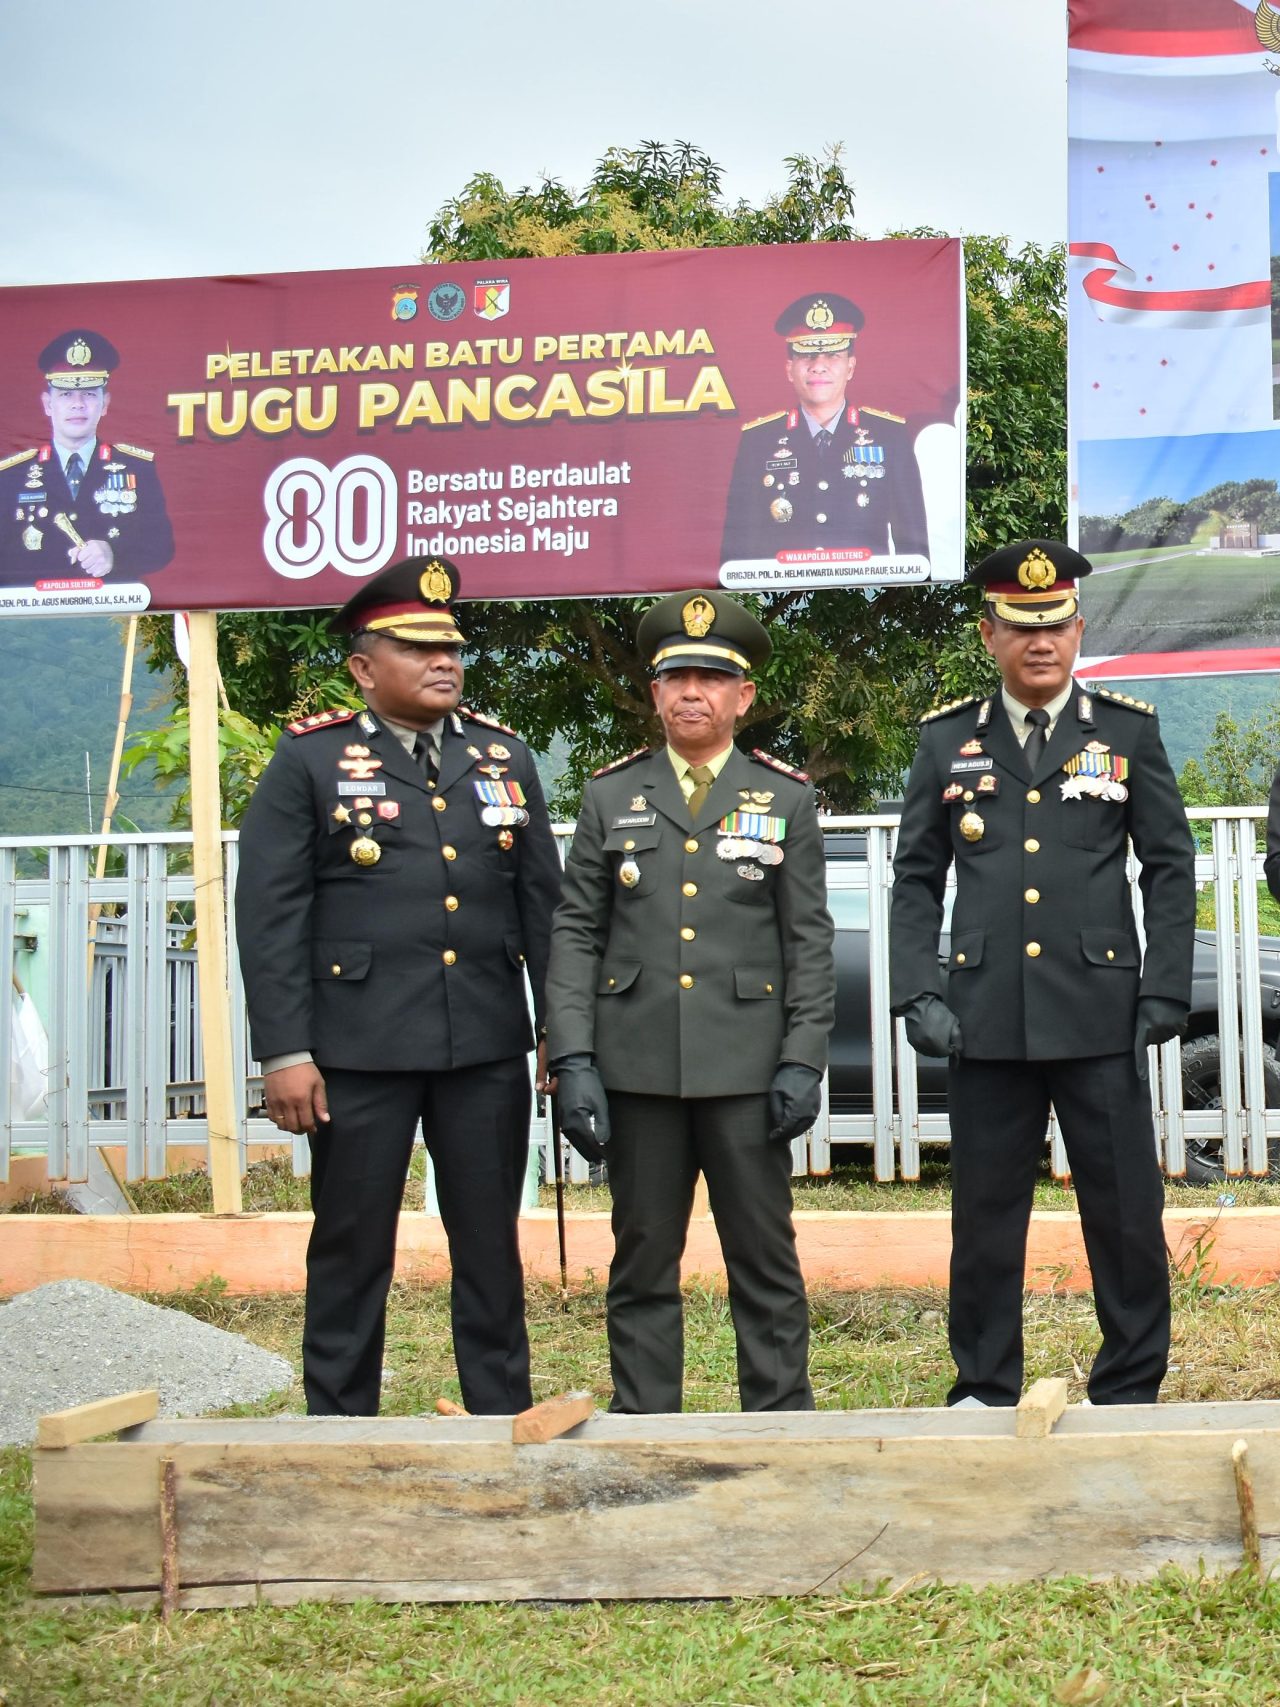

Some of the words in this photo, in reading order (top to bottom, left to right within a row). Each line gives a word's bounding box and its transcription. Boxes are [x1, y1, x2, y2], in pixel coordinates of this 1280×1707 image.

[206, 343, 414, 379] PELETAKAN
[425, 337, 523, 368] BATU
[534, 328, 715, 362] PERTAMA
[167, 385, 337, 437] TUGU
[358, 365, 736, 428] PANCASILA
[407, 468, 503, 494] Bersatu
[510, 461, 631, 489] Berdaulat
[263, 454, 398, 580] 80
[407, 499, 492, 529] Rakyat
[498, 494, 618, 526] Sejahtera
[406, 528, 526, 557] Indonesia
[532, 526, 589, 557] Maju
[785, 552, 830, 561] WAKAPOLDA
[831, 551, 863, 560] SULTENG
[43, 581, 70, 590] KAPOLDA
[758, 570, 773, 579] POL.
[774, 570, 783, 578] Dr.
[784, 569, 804, 578] HELMI
[806, 567, 834, 577] KWARTA
[835, 567, 863, 577] KUSUMA
[42, 597, 59, 606] AGUS
